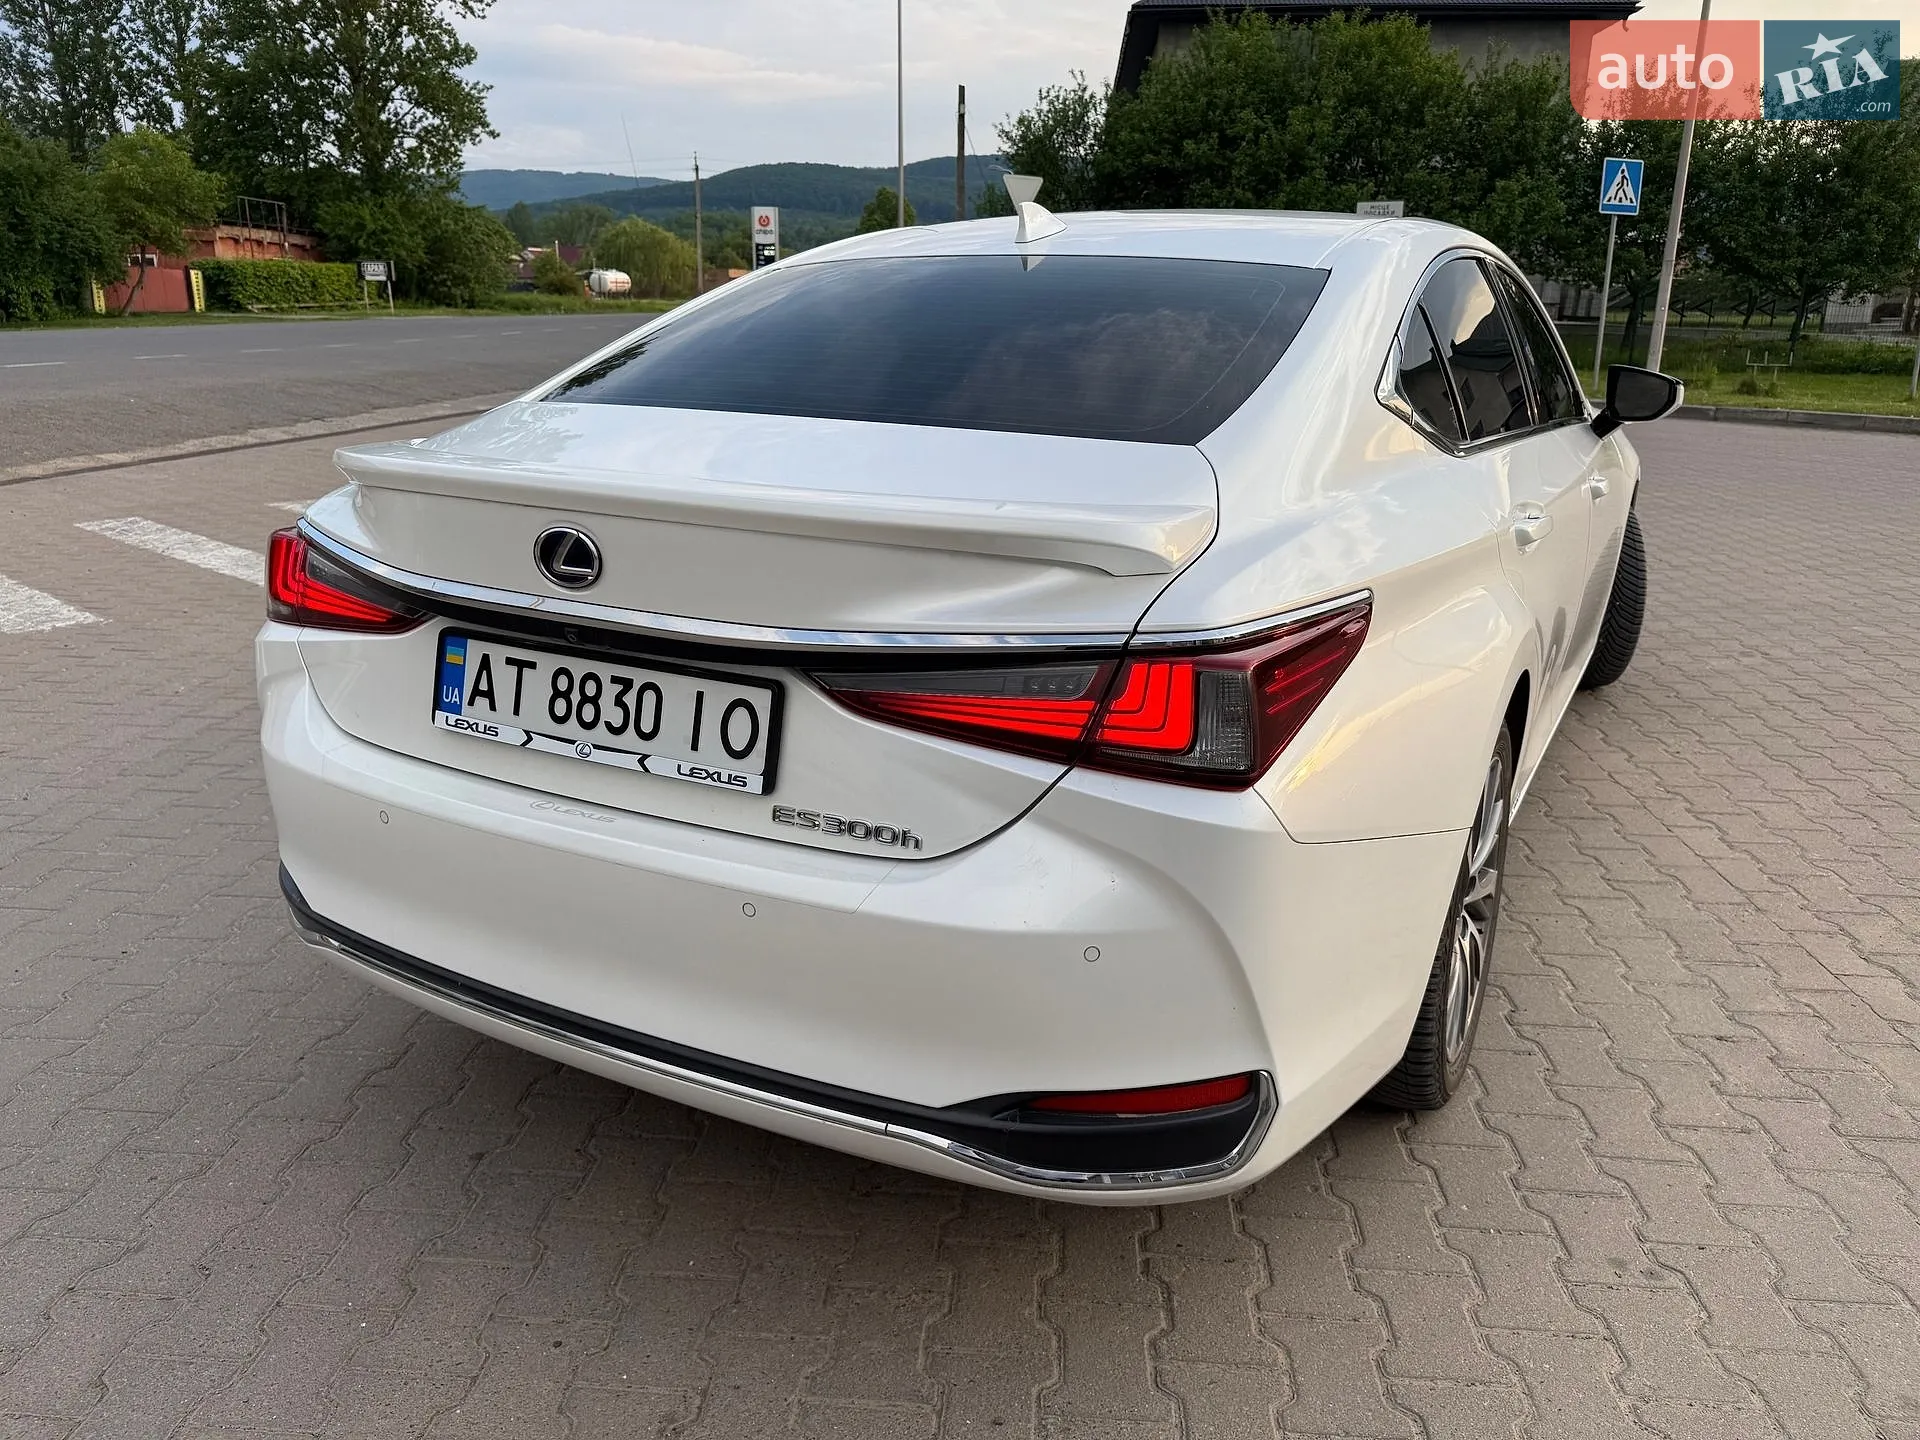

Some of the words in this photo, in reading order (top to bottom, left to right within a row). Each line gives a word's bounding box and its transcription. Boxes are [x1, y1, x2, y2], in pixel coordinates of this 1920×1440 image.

[442, 685, 460, 705] UA
[467, 653, 538, 717] AT
[548, 666, 664, 742] 8830
[445, 715, 499, 738] LEXUS
[676, 763, 748, 788] LEXUS
[553, 805, 617, 823] LEXUS
[771, 804, 923, 850] ES300h
